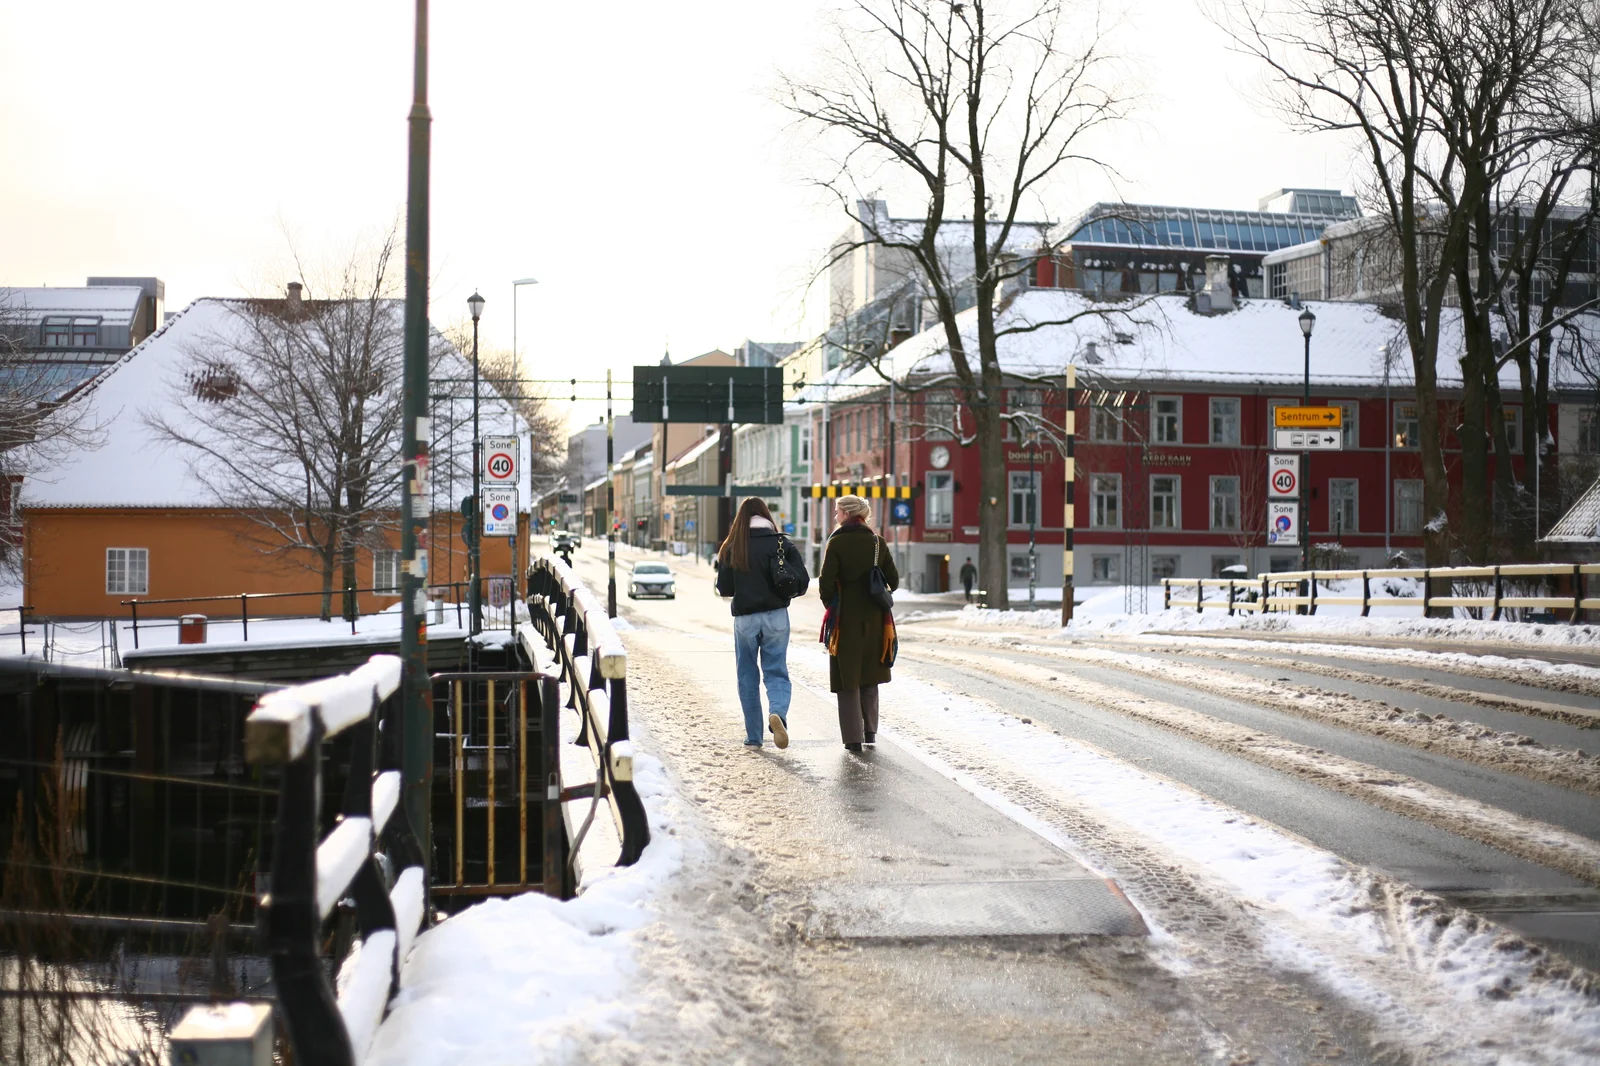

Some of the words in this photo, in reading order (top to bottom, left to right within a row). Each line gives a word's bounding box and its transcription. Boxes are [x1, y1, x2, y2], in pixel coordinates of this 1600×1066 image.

[1280, 412, 1320, 421] Sentrum
[489, 440, 512, 449] Sone
[1008, 450, 1043, 460] bonias
[492, 460, 510, 472] 40
[1274, 457, 1295, 466] Sone
[1276, 475, 1292, 488] 40
[489, 493, 511, 501] Sone
[1273, 505, 1294, 513] Sone
